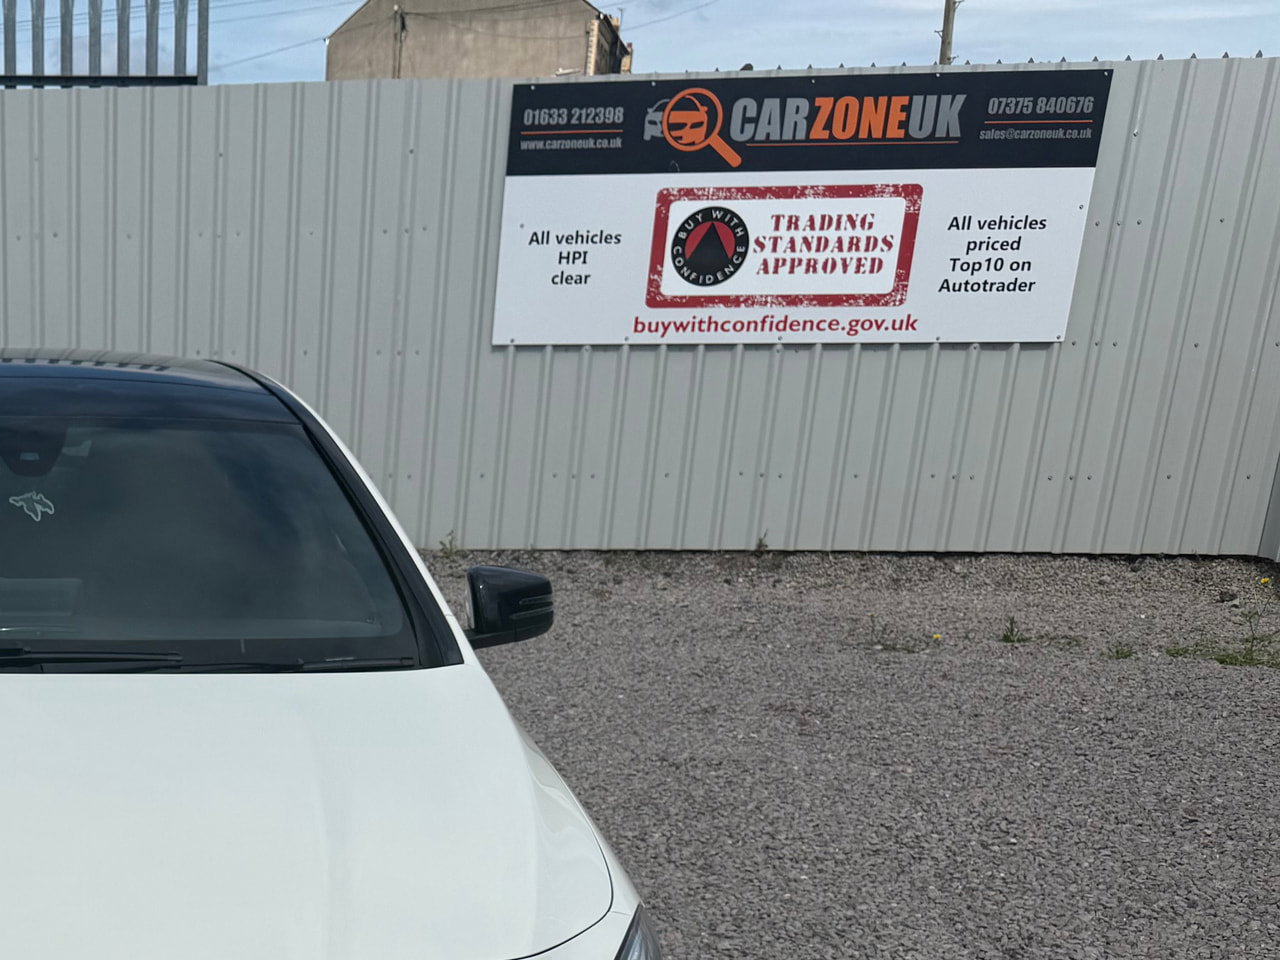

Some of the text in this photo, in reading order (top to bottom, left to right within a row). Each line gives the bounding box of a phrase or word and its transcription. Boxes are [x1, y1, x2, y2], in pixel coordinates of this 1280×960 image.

[987, 95, 1095, 115] 07375 840676
[524, 107, 625, 126] 01633 212398
[729, 94, 967, 142] CARZONEUK
[979, 127, 1093, 140] sales@carzoneuk.co.uk
[520, 136, 623, 151] www.carzoneuk.co.uk
[771, 213, 875, 232] TRADING
[947, 214, 1047, 231] All vehicles
[528, 229, 622, 246] All vehicles
[673, 208, 746, 285] BUY WITH CONFIDENCE
[753, 234, 894, 254] STANDARDS
[965, 235, 1022, 256] priced
[558, 250, 588, 265] HPI
[756, 257, 884, 275] APPROVED
[949, 257, 1032, 276] Top10 on
[551, 270, 591, 285] clear
[937, 277, 1036, 293] Autotrader
[633, 313, 919, 337] buywithconfidence.gov.uk
